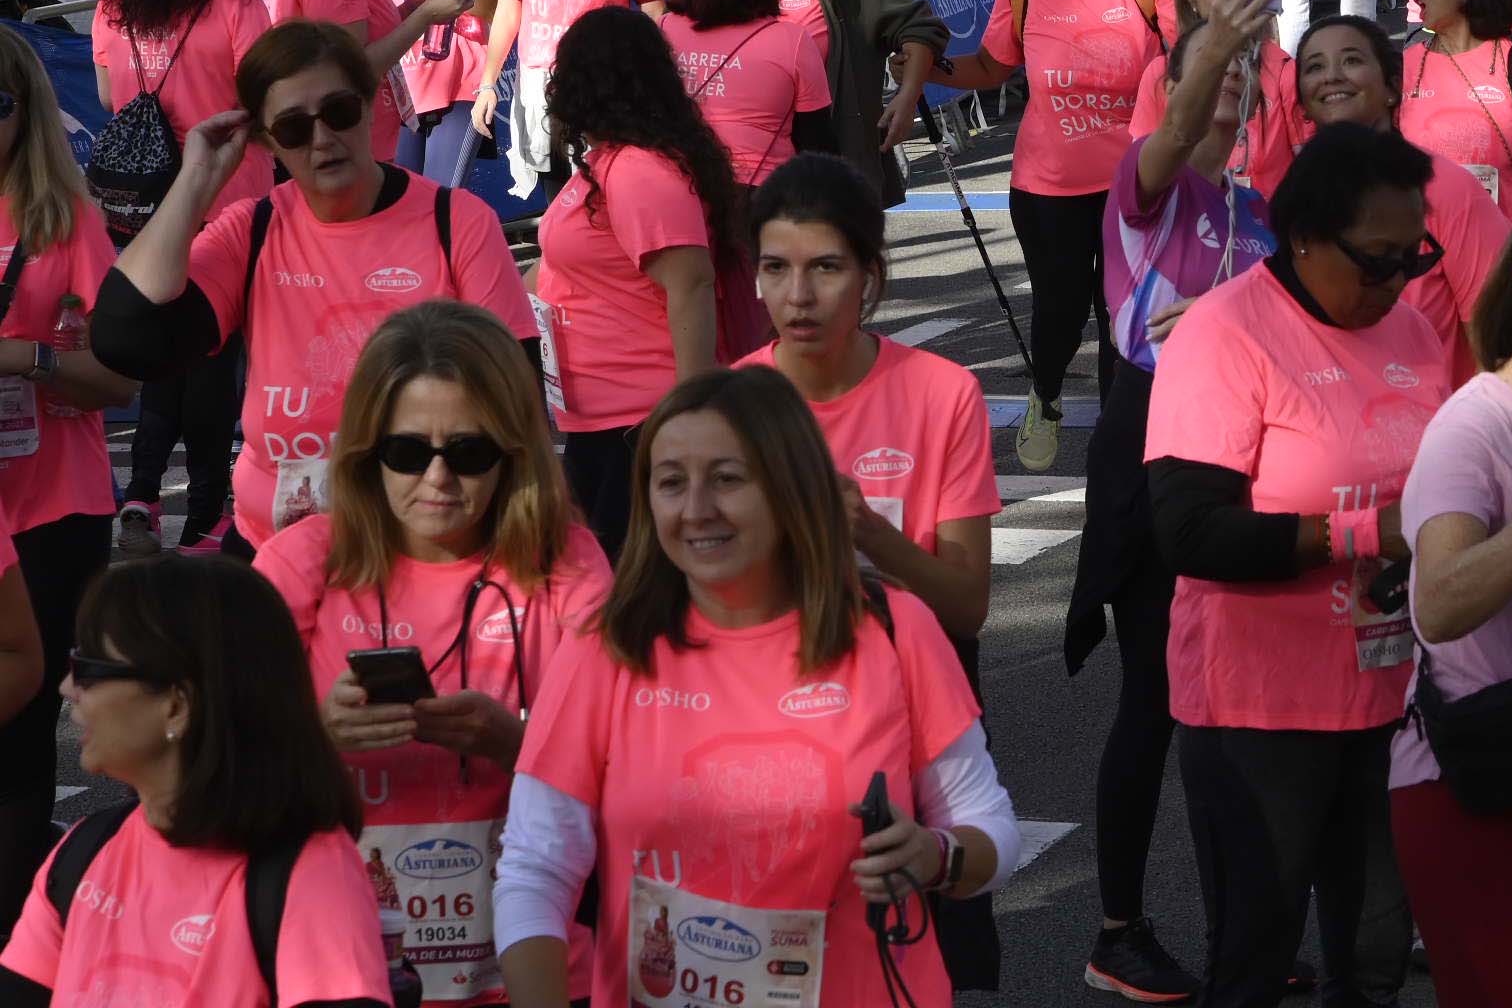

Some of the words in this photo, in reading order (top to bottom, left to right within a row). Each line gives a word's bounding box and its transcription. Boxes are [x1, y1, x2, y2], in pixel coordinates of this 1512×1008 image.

[530, 0, 548, 16] TU
[152, 41, 169, 55] LA
[677, 50, 743, 70] ARRERA
[704, 69, 725, 83] LA
[1043, 69, 1074, 89] TU
[688, 81, 726, 97] UER
[1304, 365, 1346, 386] OYSH
[263, 386, 309, 418] TU
[635, 687, 711, 712] OSHO
[350, 768, 390, 805] U
[401, 854, 477, 871] ASTURIANA
[406, 892, 475, 919] 016
[415, 925, 469, 943] 19034
[683, 925, 755, 957] ASTURIANA
[420, 950, 436, 960] DE
[438, 949, 453, 959] LA
[456, 946, 490, 959] MUJ
[680, 967, 746, 1005] 016
